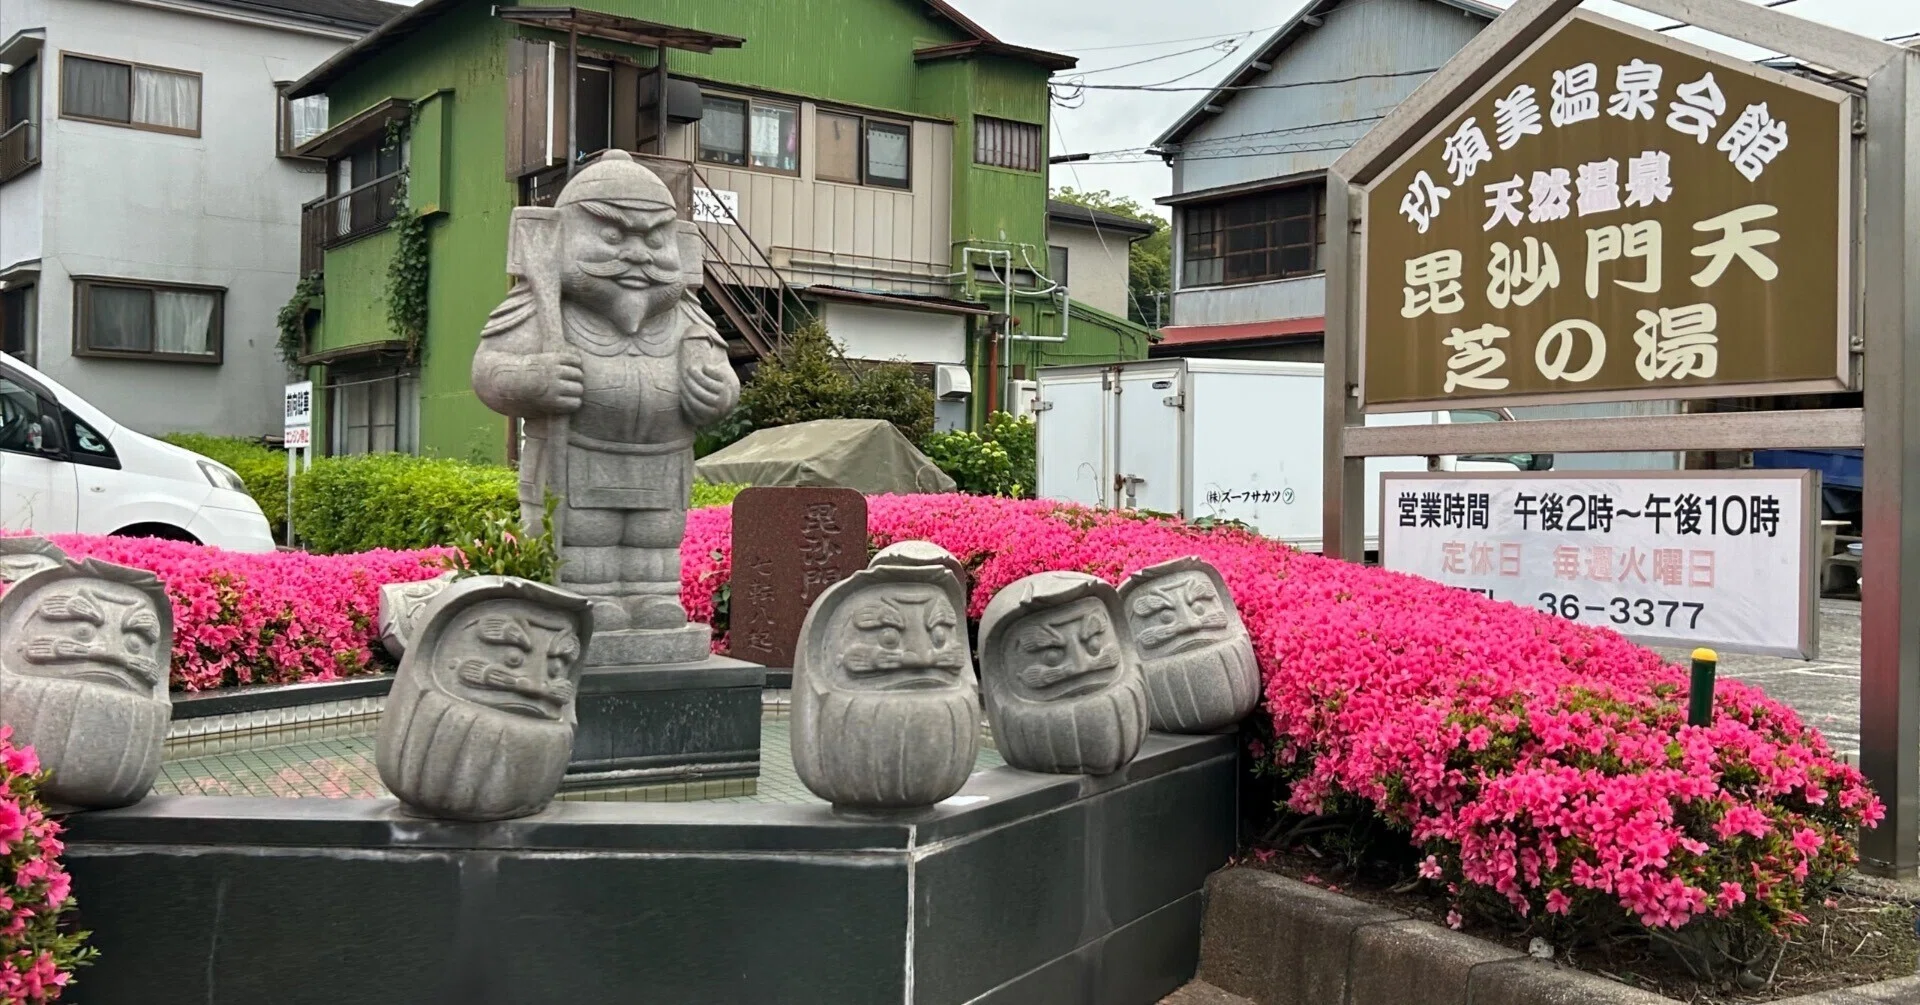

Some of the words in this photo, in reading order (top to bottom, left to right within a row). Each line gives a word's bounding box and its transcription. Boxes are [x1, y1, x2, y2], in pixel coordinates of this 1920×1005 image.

[1482, 151, 1673, 231] 天然温泉
[1400, 204, 1780, 319] 毘沙門天
[1442, 303, 1718, 393] 芝の湯
[1398, 492, 1490, 530] 営業時間
[799, 501, 842, 612] 毘沙門
[1441, 541, 1521, 578] 定休日
[1552, 545, 1716, 589] 毎週火曜日
[1537, 592, 1705, 630] 36-3377
